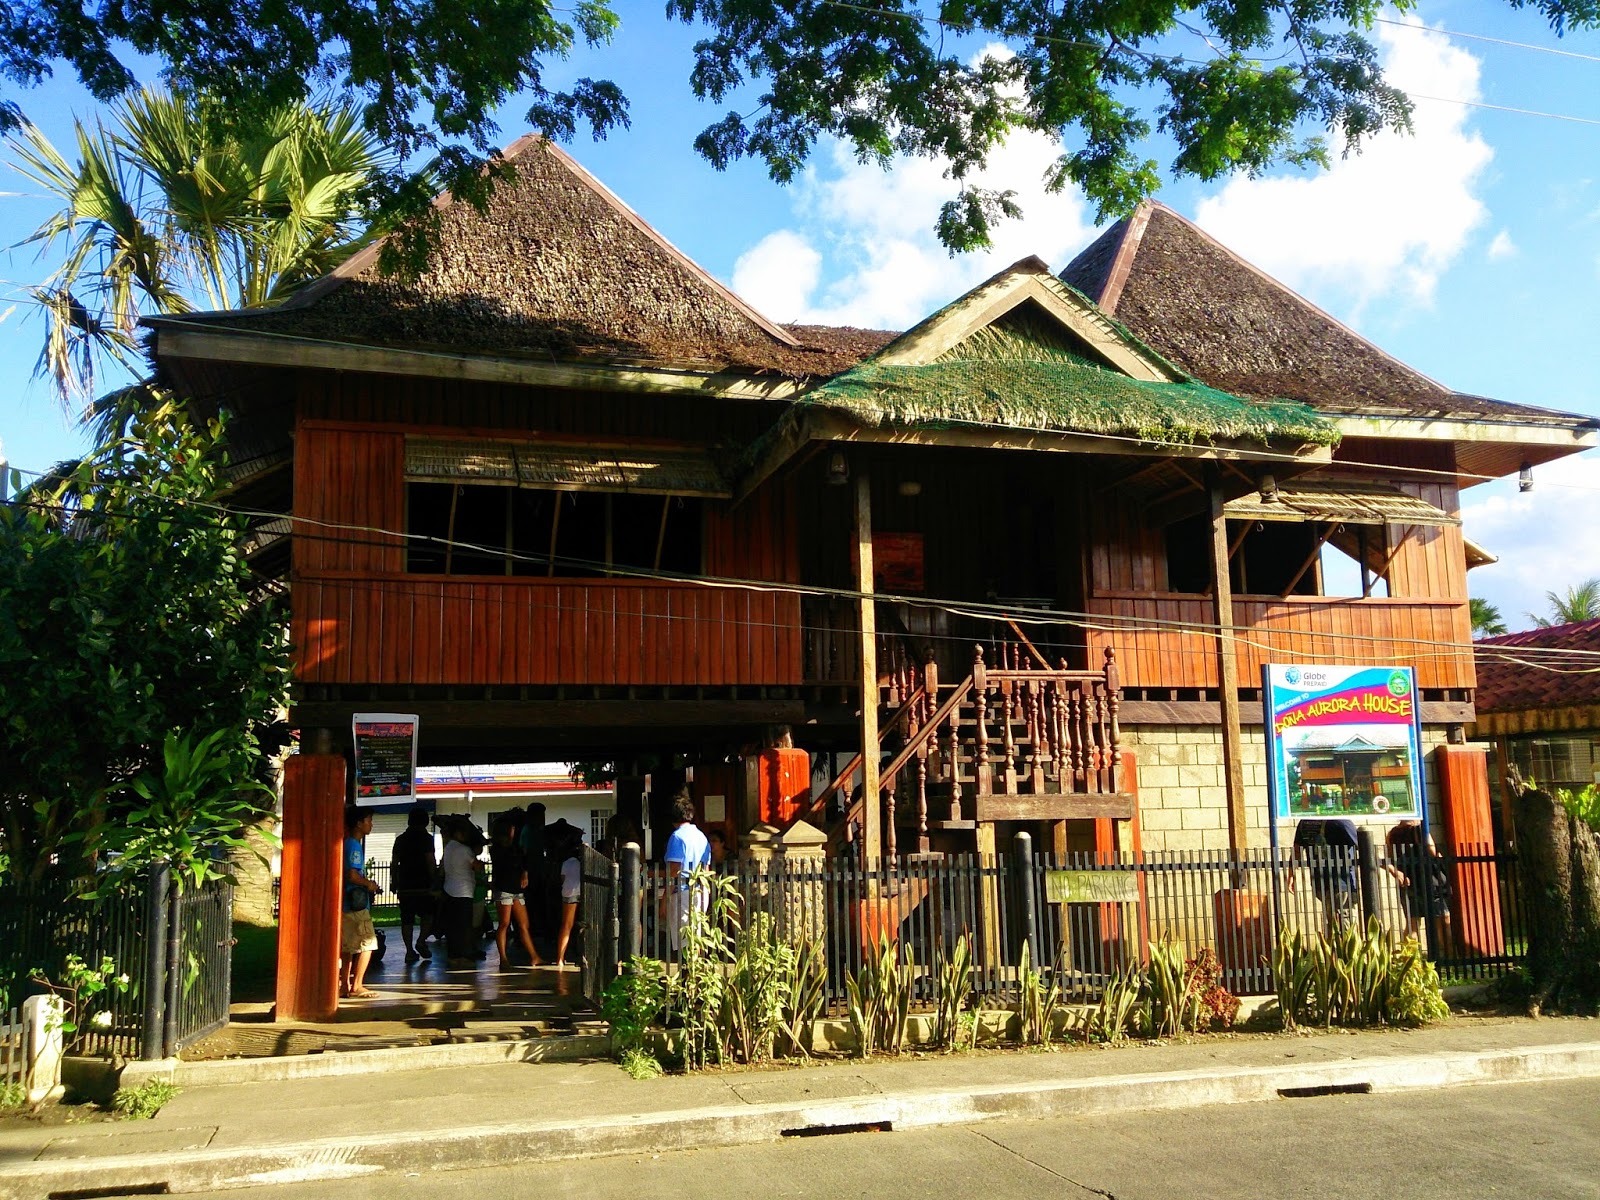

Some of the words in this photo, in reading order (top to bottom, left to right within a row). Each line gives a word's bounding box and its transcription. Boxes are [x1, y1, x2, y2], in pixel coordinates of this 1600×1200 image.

[1303, 672, 1327, 681] Globe
[1275, 695, 1302, 712] WELCOME
[1301, 692, 1310, 702] TO
[1307, 696, 1361, 717] AURORA
[1363, 693, 1411, 716] HOUSE
[1051, 875, 1071, 900] NO
[1077, 875, 1134, 900] PARKING
